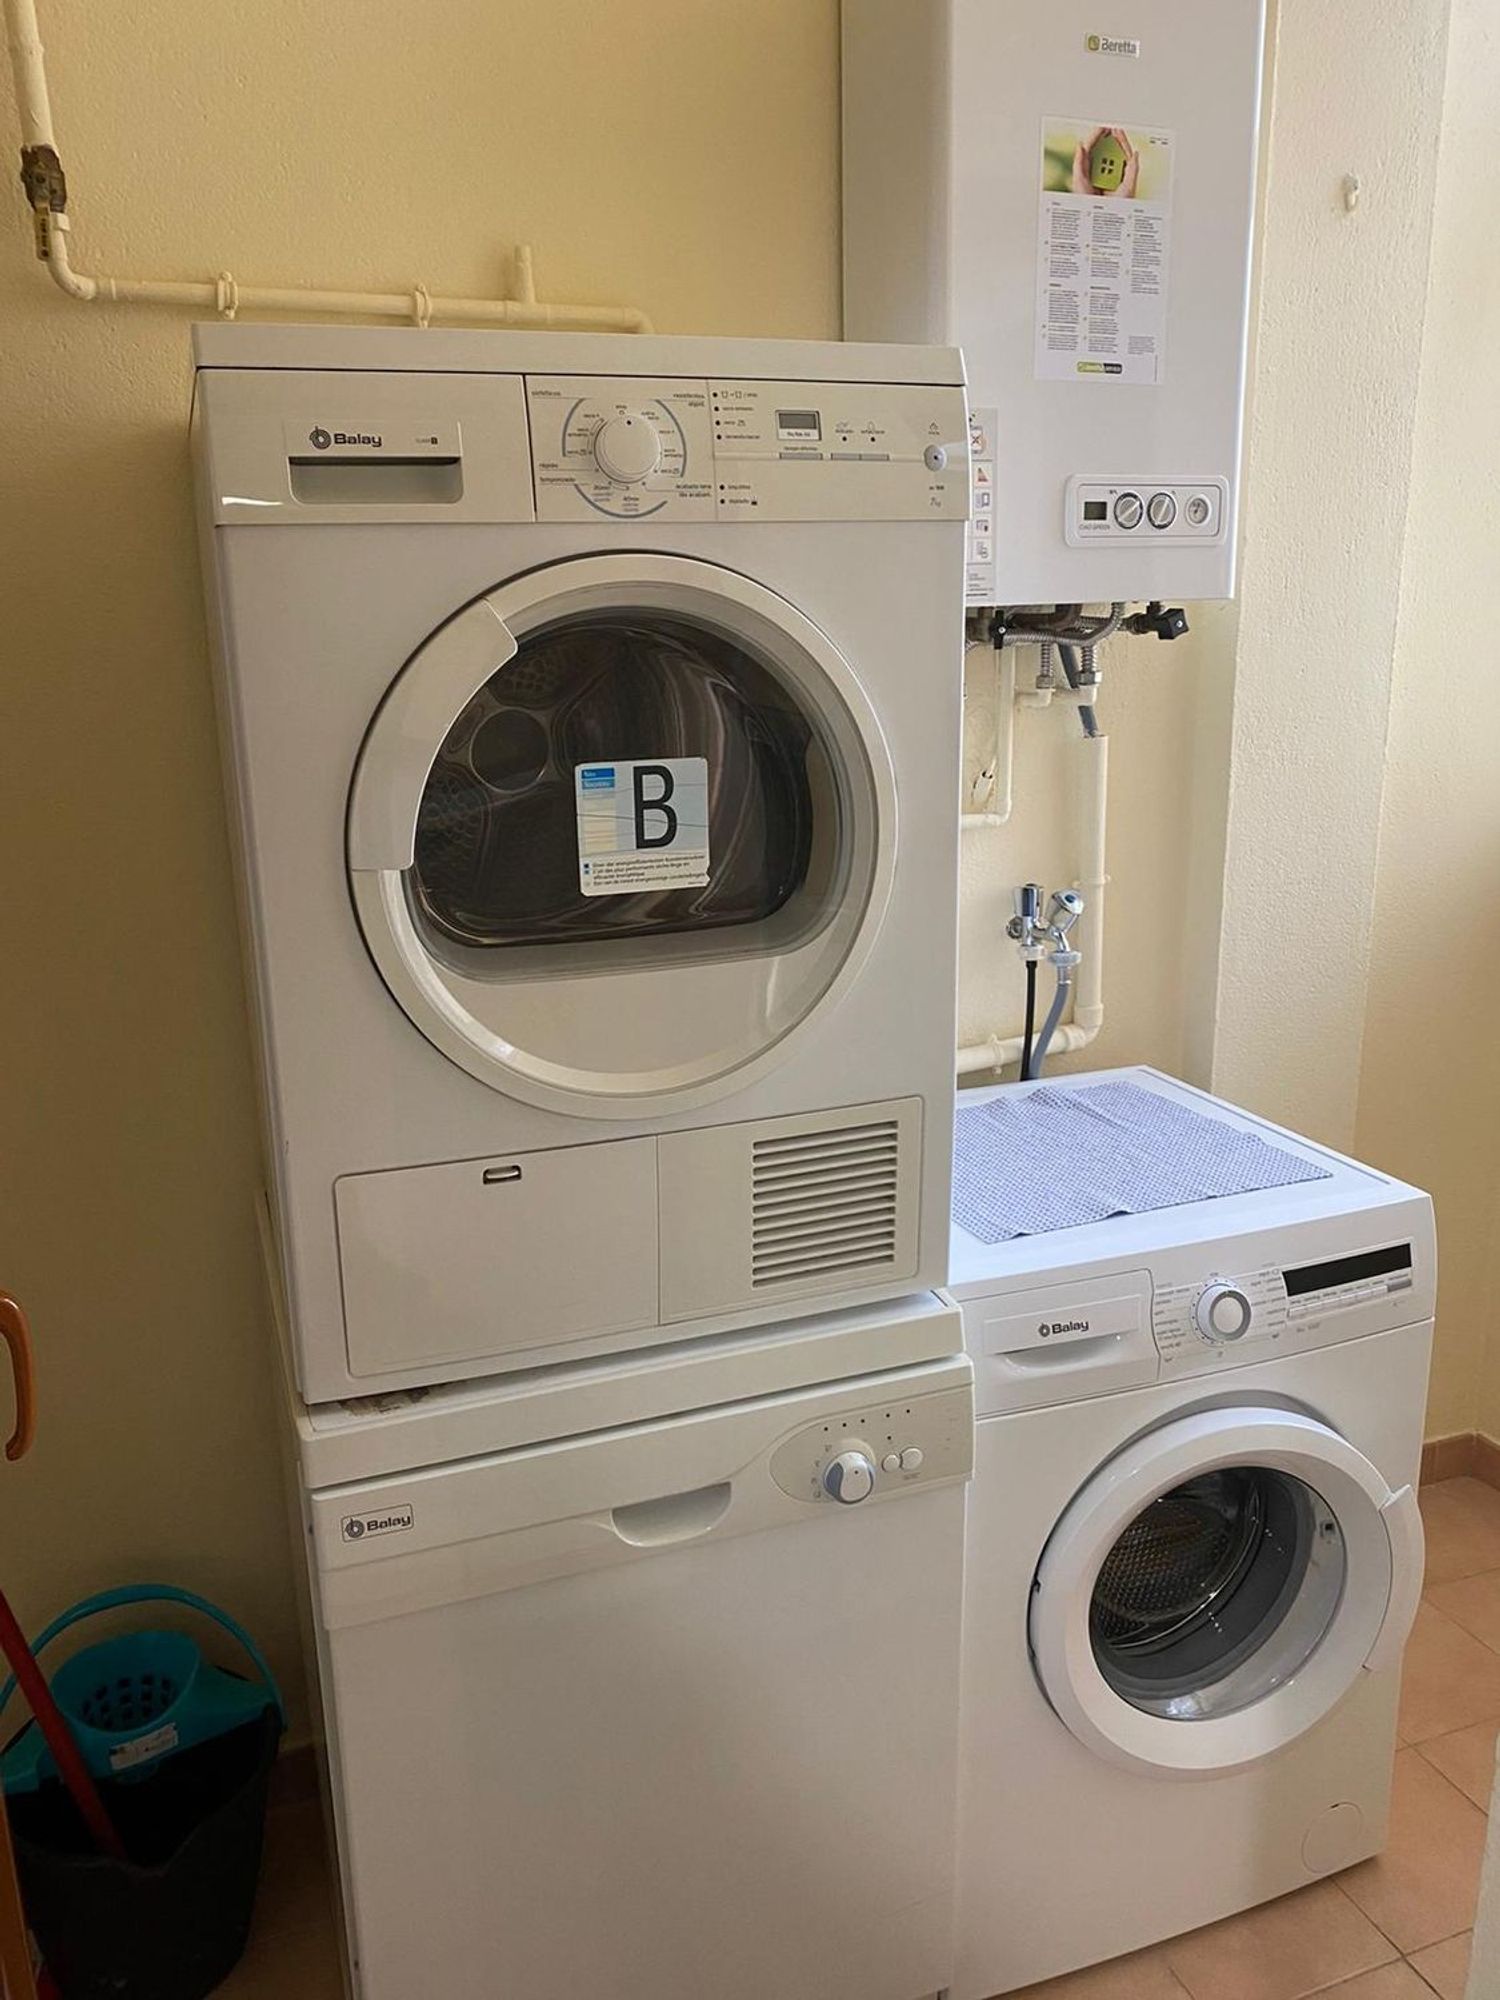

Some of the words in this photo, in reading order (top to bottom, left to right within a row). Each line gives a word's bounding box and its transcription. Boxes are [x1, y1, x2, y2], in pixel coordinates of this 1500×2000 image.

[1101, 37, 1137, 54] Beretta
[333, 433, 383, 448] Balay
[633, 764, 678, 850] B
[1051, 1320, 1089, 1335] Balay
[366, 1515, 411, 1532] Balay
